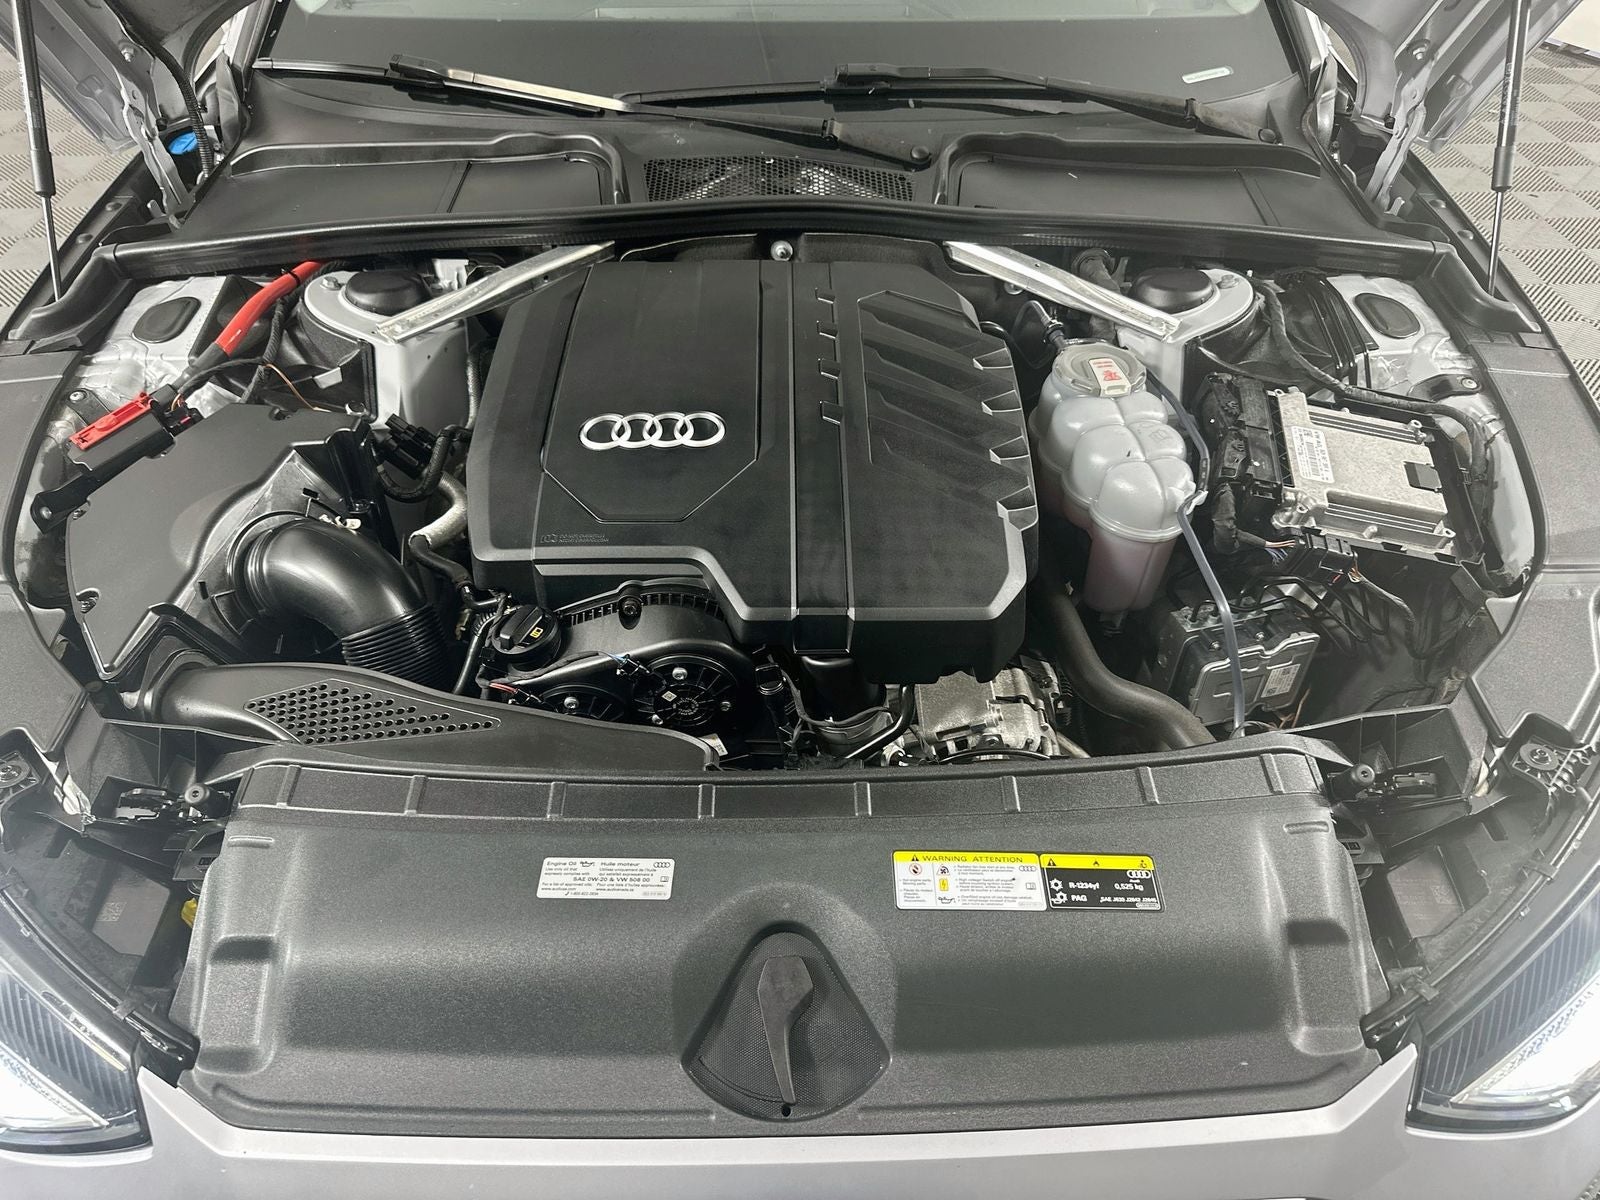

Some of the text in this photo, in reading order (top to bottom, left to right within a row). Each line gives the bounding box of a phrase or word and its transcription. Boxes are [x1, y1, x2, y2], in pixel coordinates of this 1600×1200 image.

[1068, 882, 1144, 891] R-1234yf 0,525 kg
[1070, 894, 1088, 902] PAG
